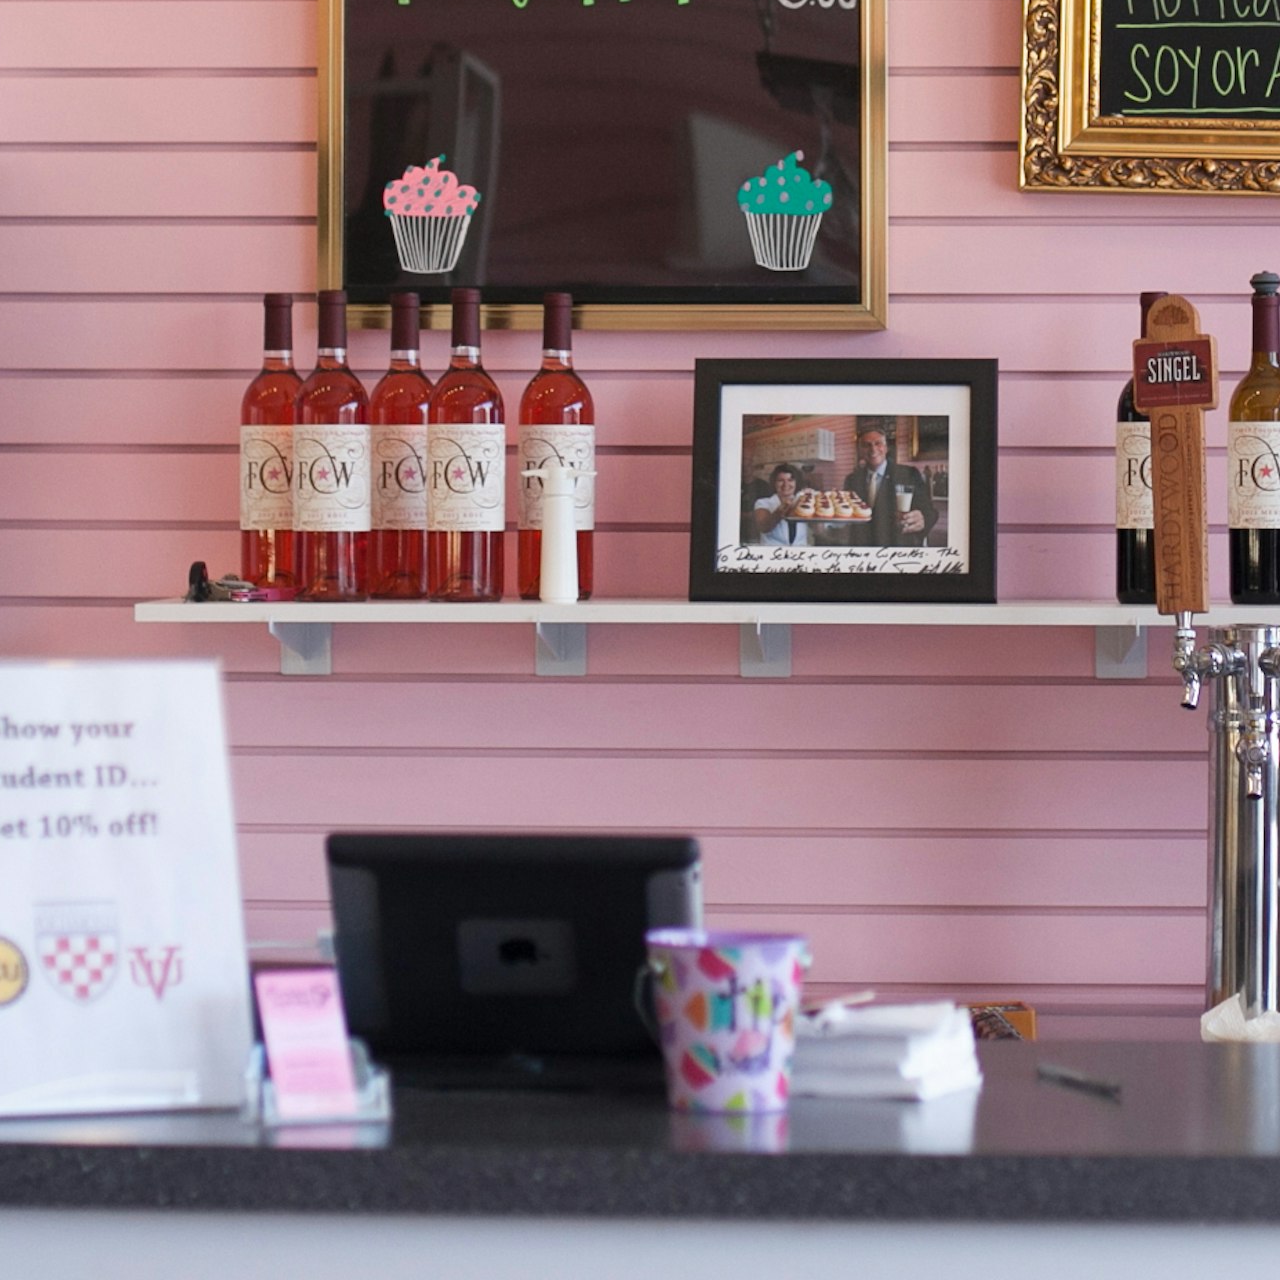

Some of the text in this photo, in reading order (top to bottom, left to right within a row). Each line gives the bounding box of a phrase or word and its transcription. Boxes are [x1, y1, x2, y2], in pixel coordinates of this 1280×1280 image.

[1146, 355, 1202, 385] SINGEL
[70, 721, 135, 746] your
[40, 815, 100, 838] 10%
[108, 812, 159, 837] off!
